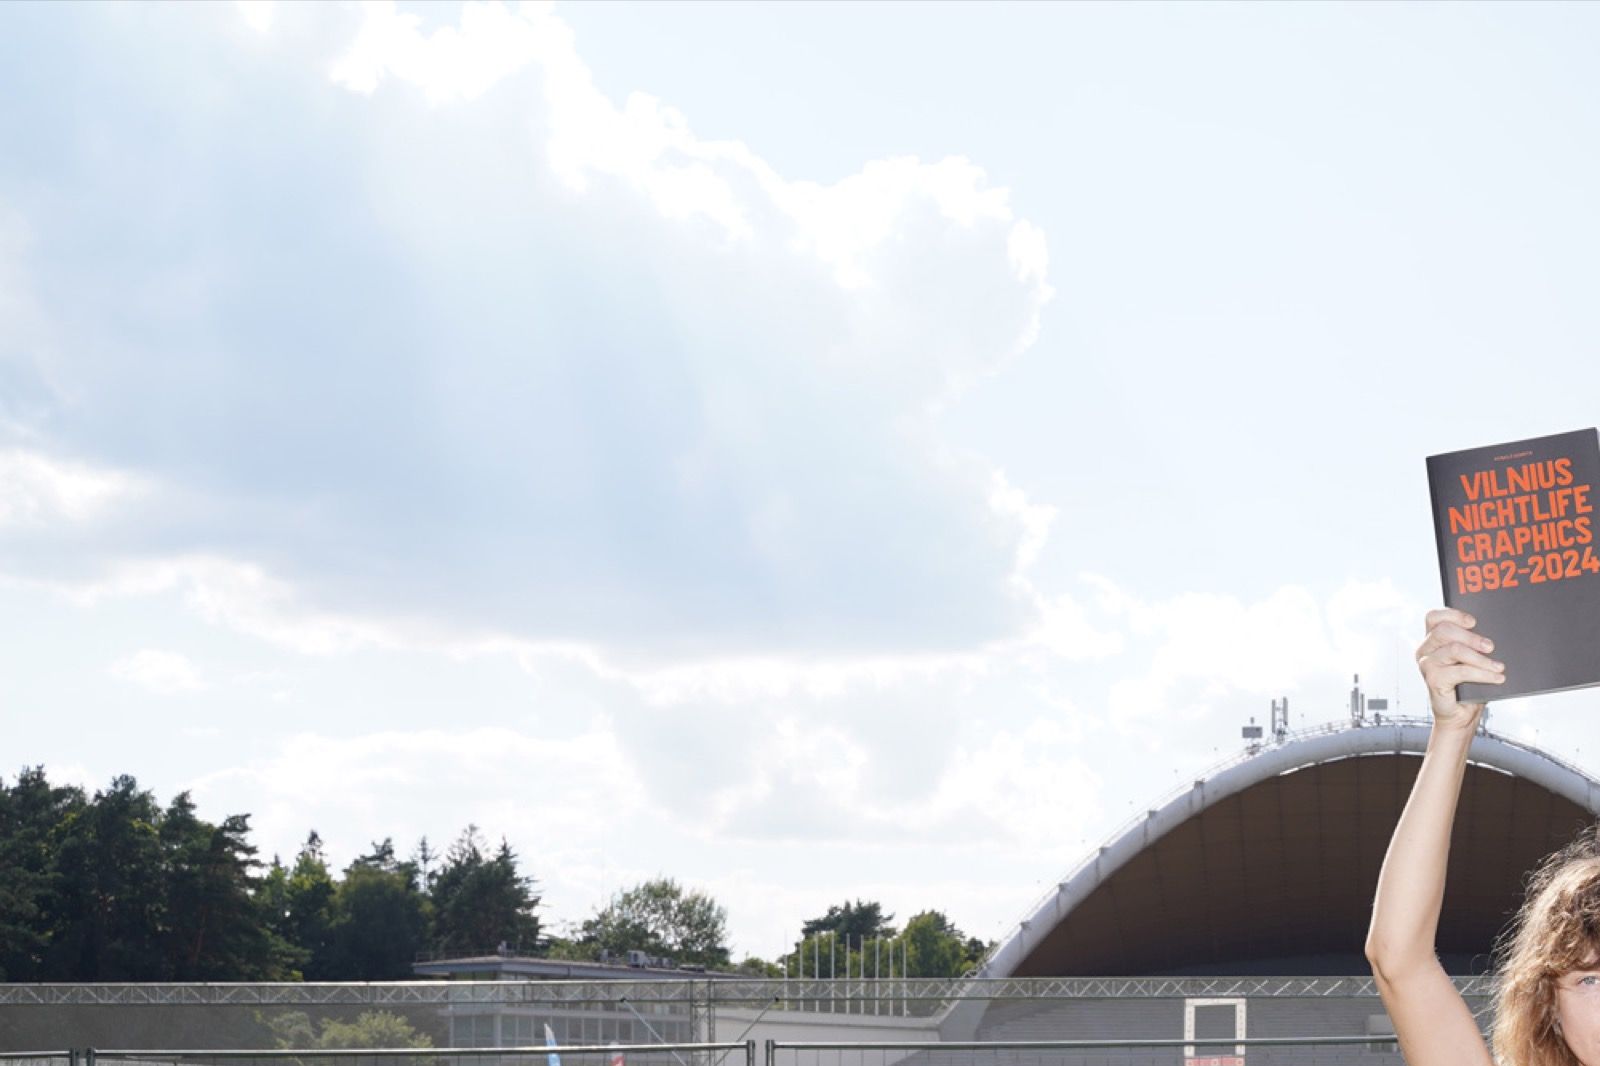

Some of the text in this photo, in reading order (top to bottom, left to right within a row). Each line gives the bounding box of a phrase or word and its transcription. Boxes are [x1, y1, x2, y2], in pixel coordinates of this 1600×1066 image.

[1460, 458, 1574, 501] VILNIUS
[1448, 484, 1593, 535] NIGHTLIFE
[1457, 517, 1593, 563] GRAPHICS
[1457, 546, 1600, 594] 1992-2024
